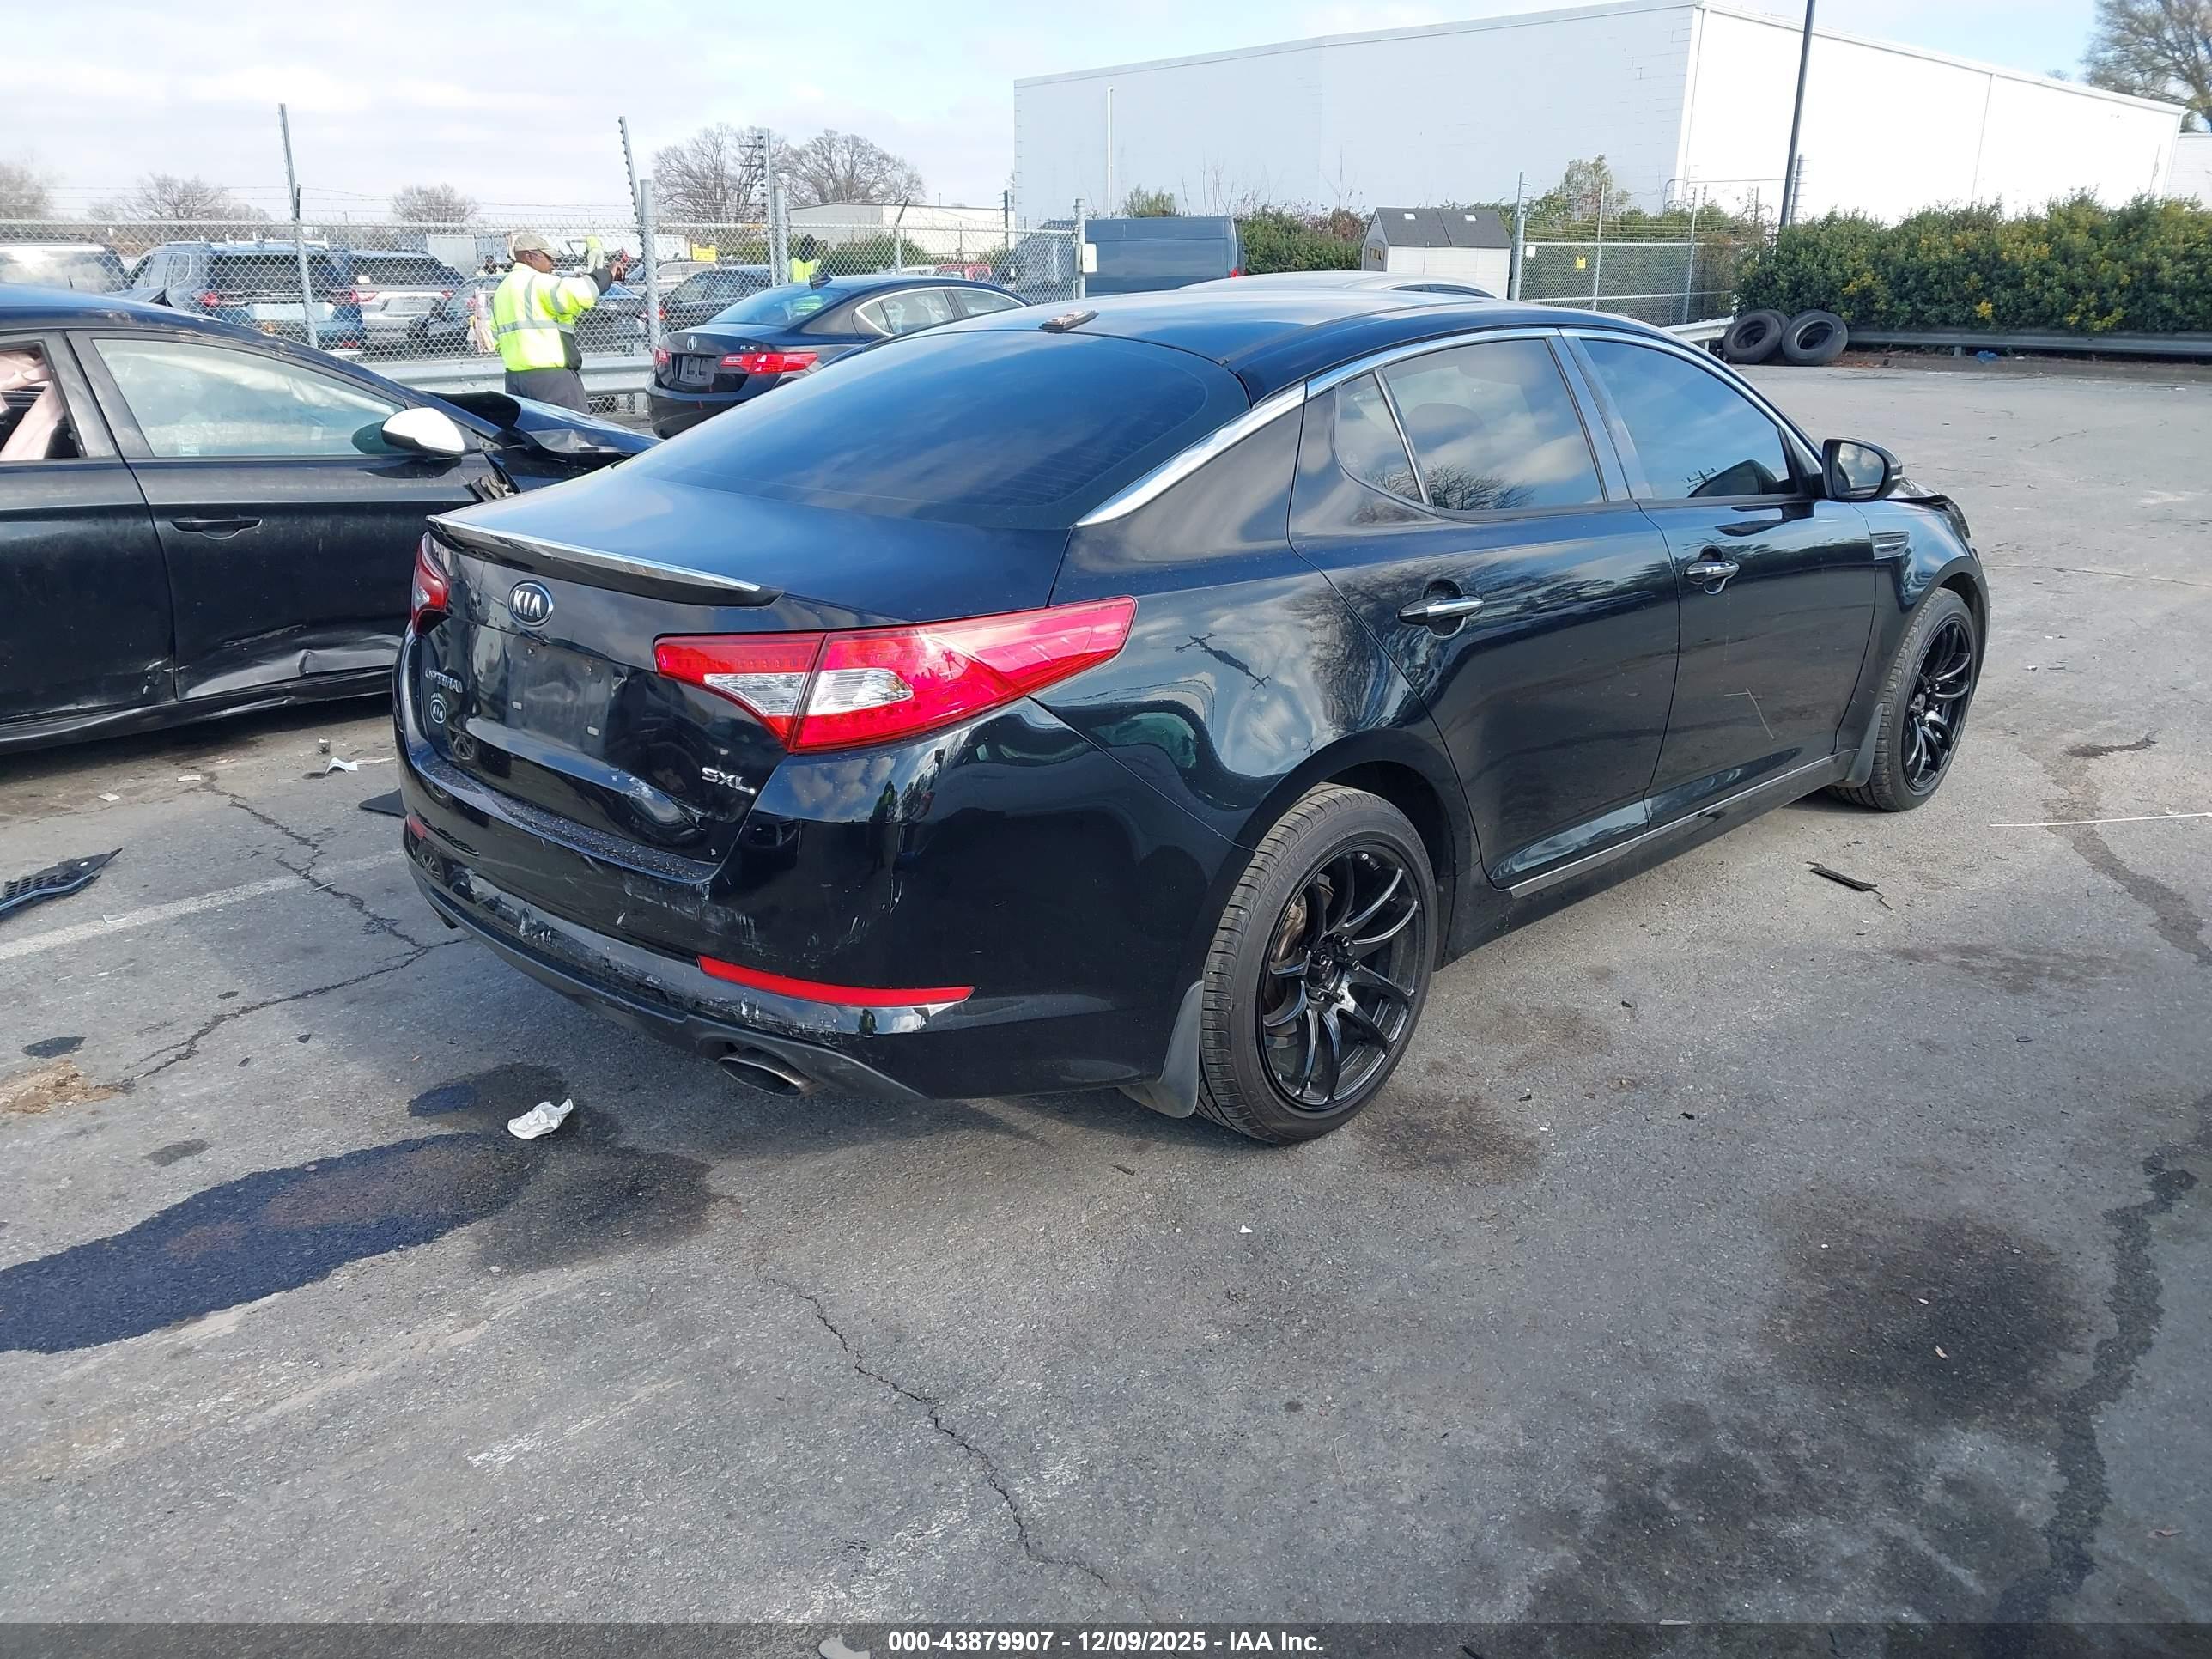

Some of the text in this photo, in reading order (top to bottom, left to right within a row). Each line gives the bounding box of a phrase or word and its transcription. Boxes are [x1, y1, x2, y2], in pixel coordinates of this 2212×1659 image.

[513, 589, 542, 618] KIA
[432, 704, 444, 720] KIA
[702, 767, 756, 794] SXL
